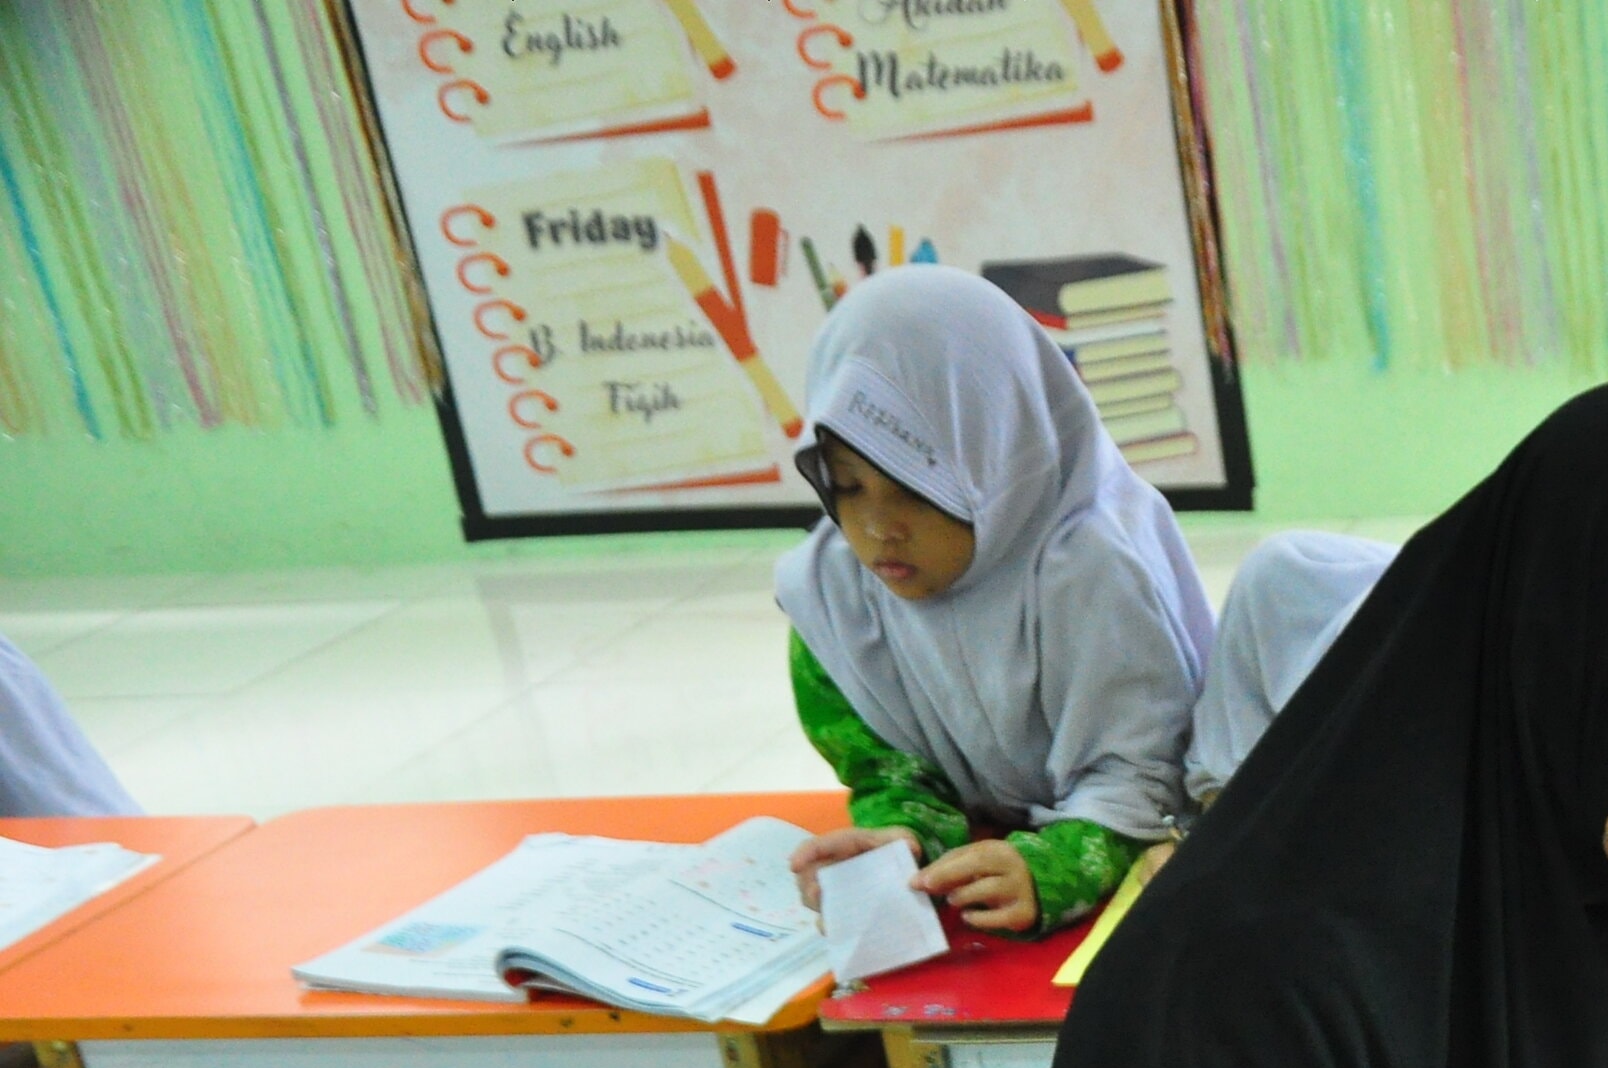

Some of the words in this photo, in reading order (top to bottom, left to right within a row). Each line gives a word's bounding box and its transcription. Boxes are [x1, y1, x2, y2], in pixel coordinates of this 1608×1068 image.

[502, 10, 621, 66] English
[856, 48, 1066, 98] Matematika
[522, 208, 659, 251] Friday
[579, 318, 715, 352] Indonesia
